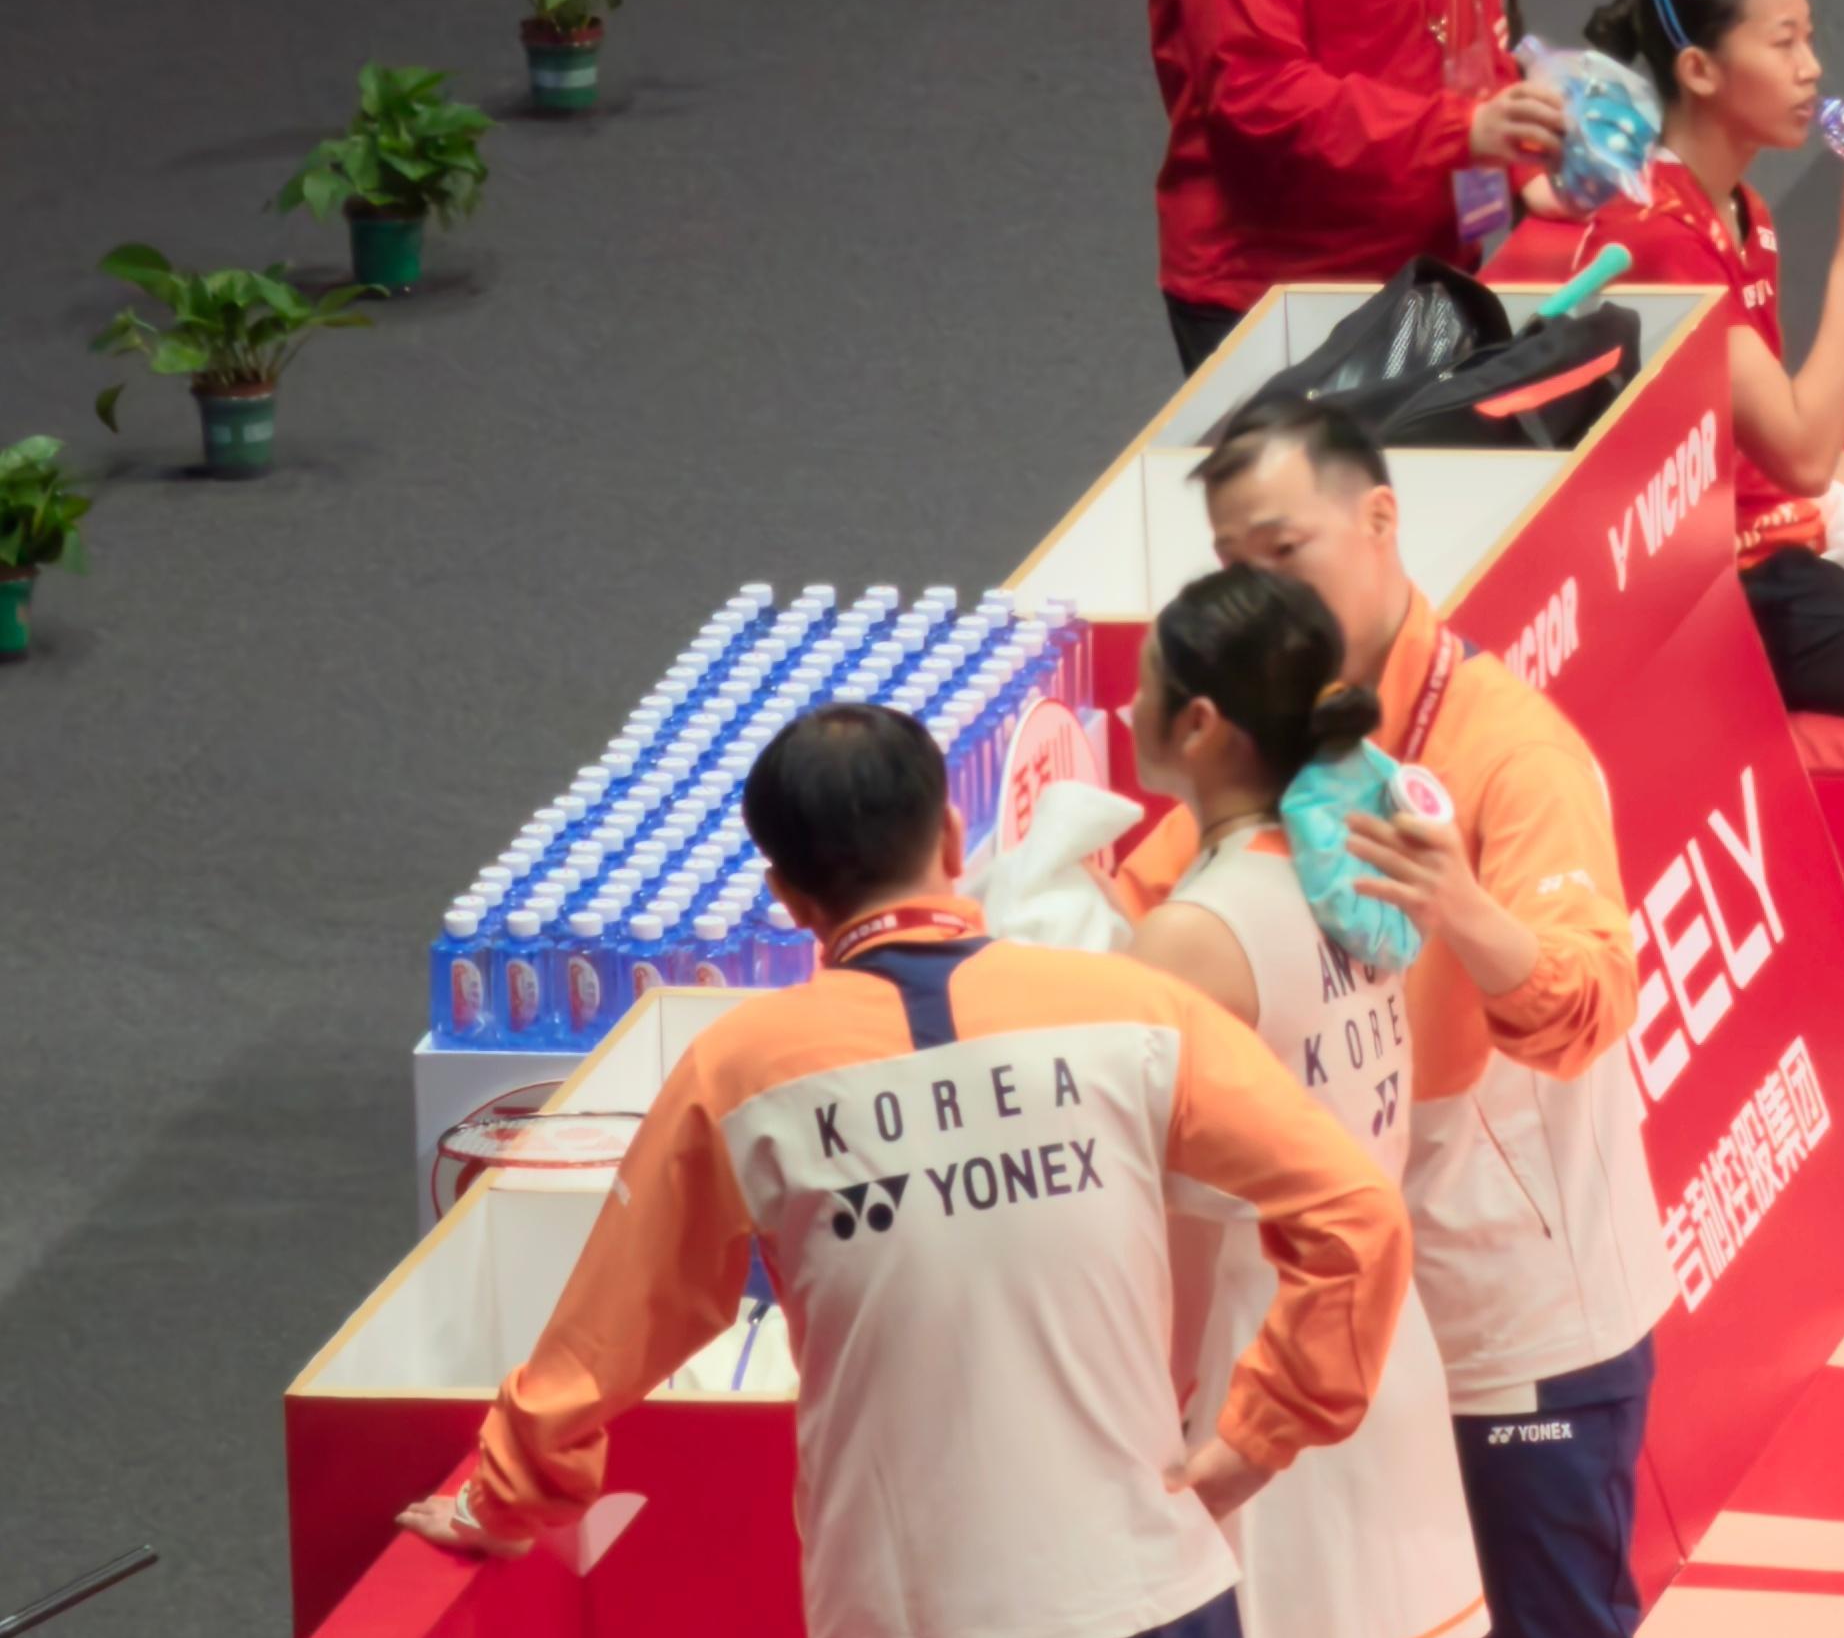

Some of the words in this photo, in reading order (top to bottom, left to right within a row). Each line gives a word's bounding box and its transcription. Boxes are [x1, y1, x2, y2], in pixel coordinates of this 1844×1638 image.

[1634, 407, 1718, 559] VICTOR
[1632, 767, 1784, 1121] EELY
[814, 1057, 1082, 1158] KOREA
[925, 1137, 1104, 1217] YONEX
[1662, 1033, 1830, 1313] 吉利控股集团
[1518, 1422, 1573, 1442] YONEX
